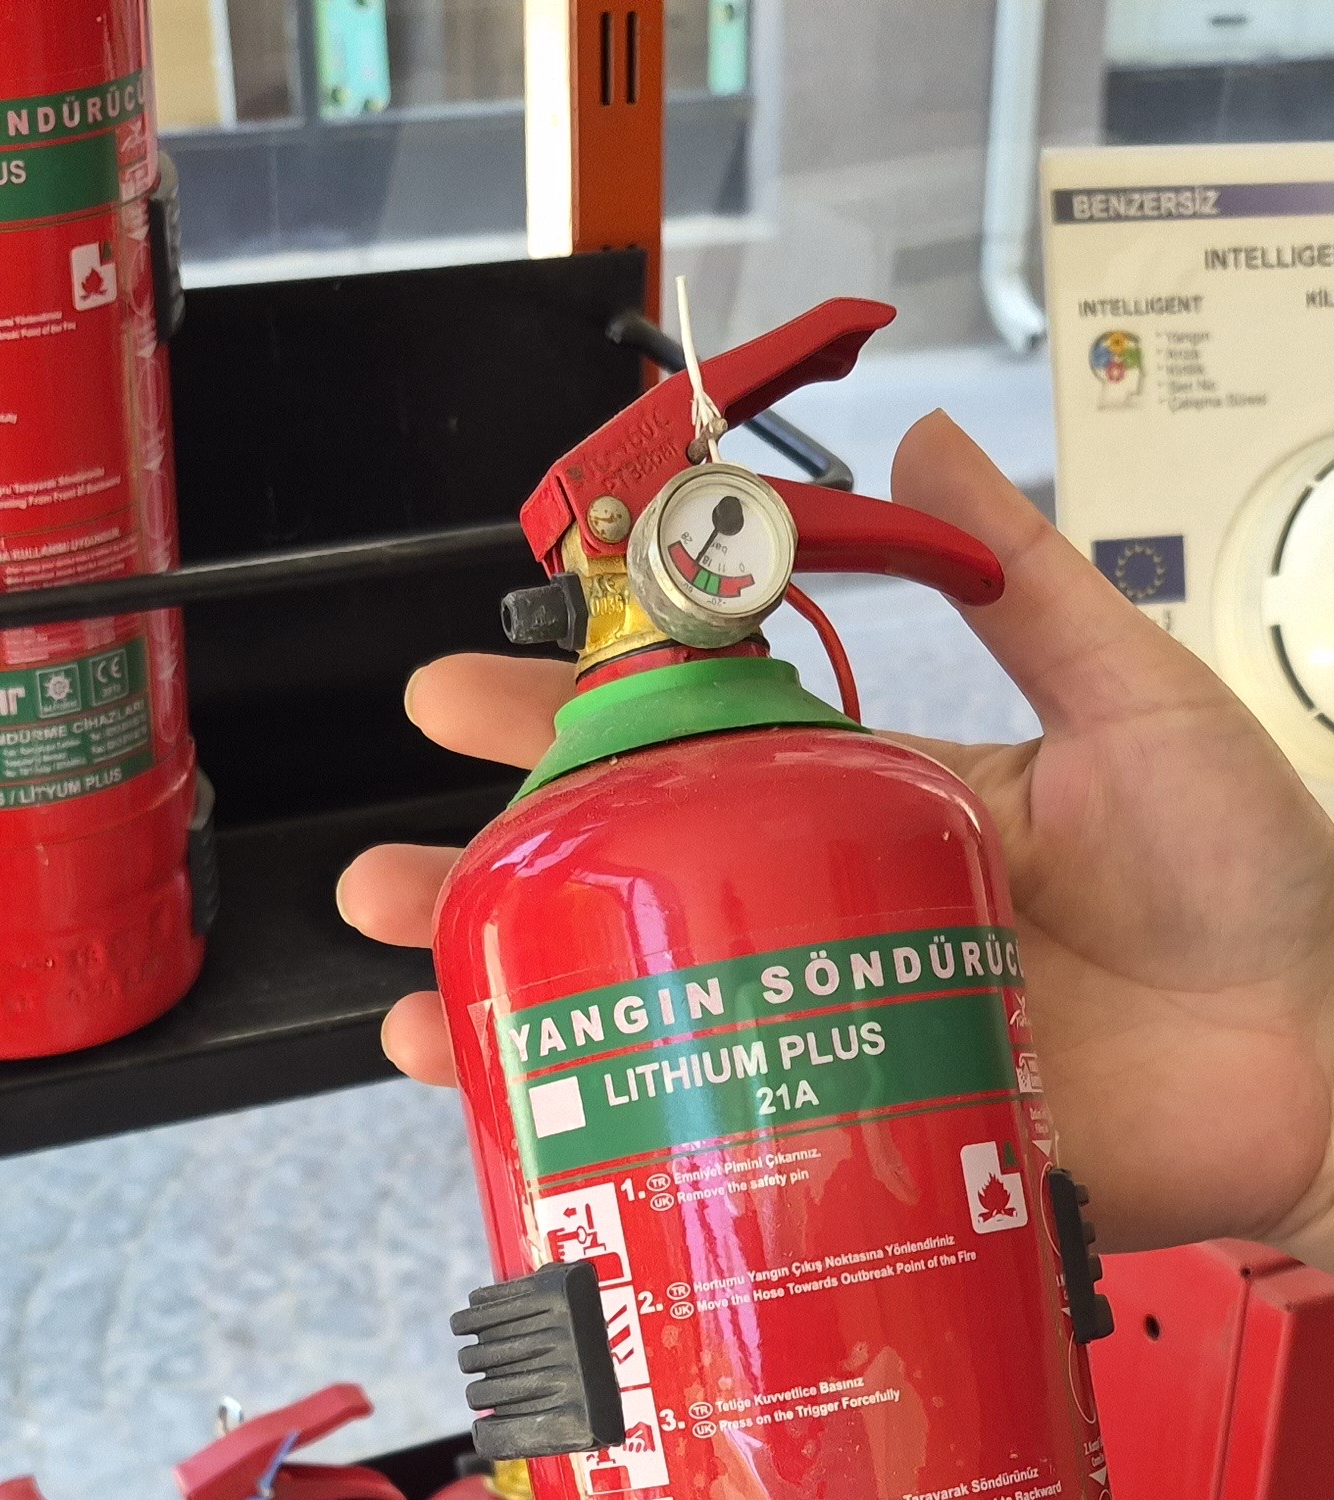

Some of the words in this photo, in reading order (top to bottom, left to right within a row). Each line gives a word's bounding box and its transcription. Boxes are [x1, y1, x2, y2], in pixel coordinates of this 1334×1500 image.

[1072, 186, 1221, 220] BENZERSİZ
[1078, 296, 1205, 317] INTELLIGENT
[85, 768, 122, 790] PLUS
[508, 977, 724, 1062] YANGIN
[604, 1041, 767, 1107] LITHIUM
[779, 1021, 885, 1070] PLUS
[756, 1080, 819, 1116] 21A
[621, 1178, 646, 1202] 1.
[677, 1187, 730, 1204] Remove
[728, 1180, 748, 1193] the
[750, 1175, 787, 1190] safety
[790, 1168, 810, 1184] pin
[638, 1291, 664, 1315] 2.
[748, 1268, 789, 1284] Yangın
[825, 1248, 884, 1269] Noktasına
[697, 1300, 729, 1312] Move
[731, 1293, 750, 1305] the
[753, 1289, 785, 1302] Hose
[786, 1276, 838, 1295] Towards
[841, 1266, 895, 1285] Outbreak
[896, 1259, 926, 1274] Point
[928, 1256, 938, 1268] of
[940, 1253, 956, 1267] the
[958, 1250, 977, 1263] Fire
[659, 1409, 686, 1431] 3.
[719, 1415, 753, 1431] Press
[756, 1412, 771, 1425] on
[774, 1408, 794, 1421] the
[795, 1397, 839, 1419] Trigger
[842, 1387, 900, 1409] Forcefully
[971, 1466, 1039, 1494] Söndürünüz
